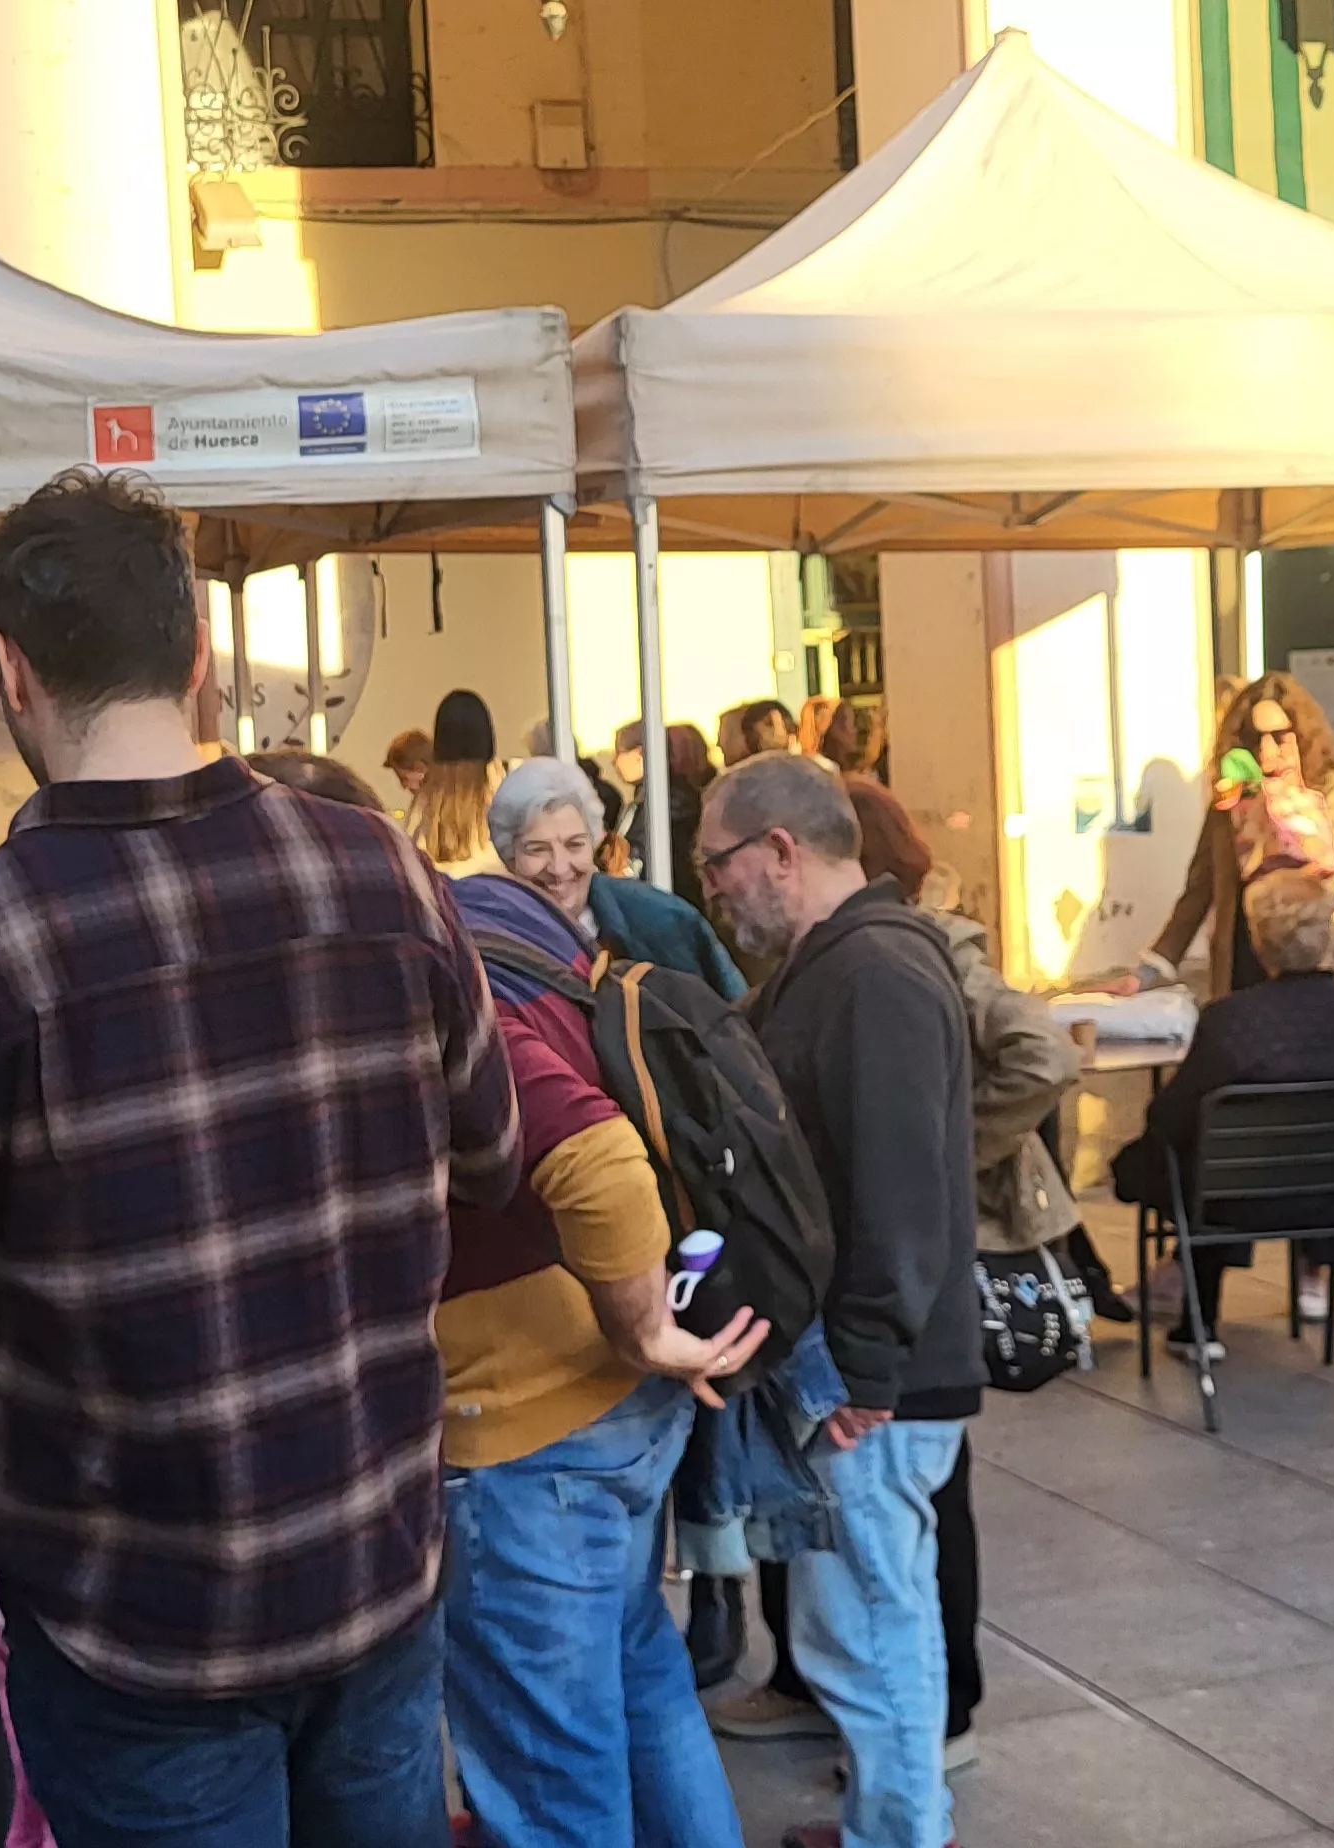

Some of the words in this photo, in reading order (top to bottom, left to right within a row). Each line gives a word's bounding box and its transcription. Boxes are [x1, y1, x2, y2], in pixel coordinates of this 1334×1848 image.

[168, 413, 288, 436] Ayuntamiento
[168, 435, 189, 451] de
[194, 434, 260, 449] Huesca
